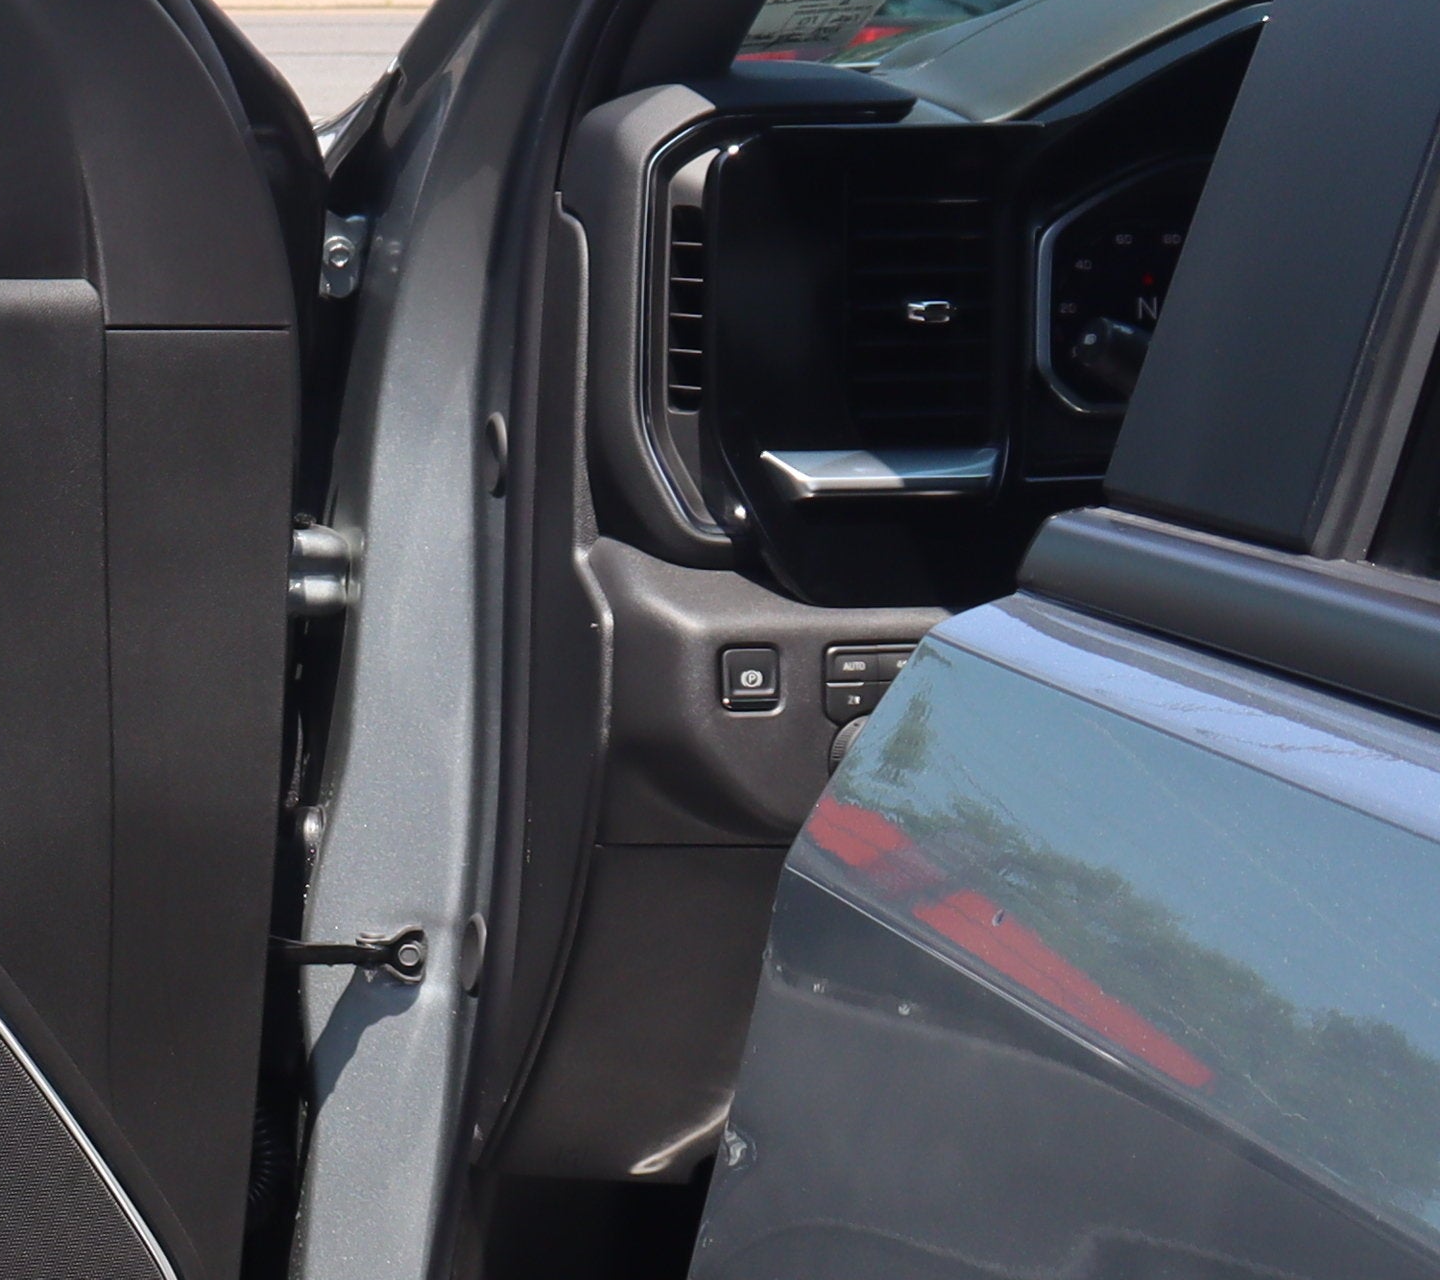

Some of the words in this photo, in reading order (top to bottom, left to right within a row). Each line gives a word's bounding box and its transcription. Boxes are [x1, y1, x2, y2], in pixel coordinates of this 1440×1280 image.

[1074, 258, 1092, 270] 40
[1136, 295, 1158, 320] N
[843, 661, 866, 672] AUTO
